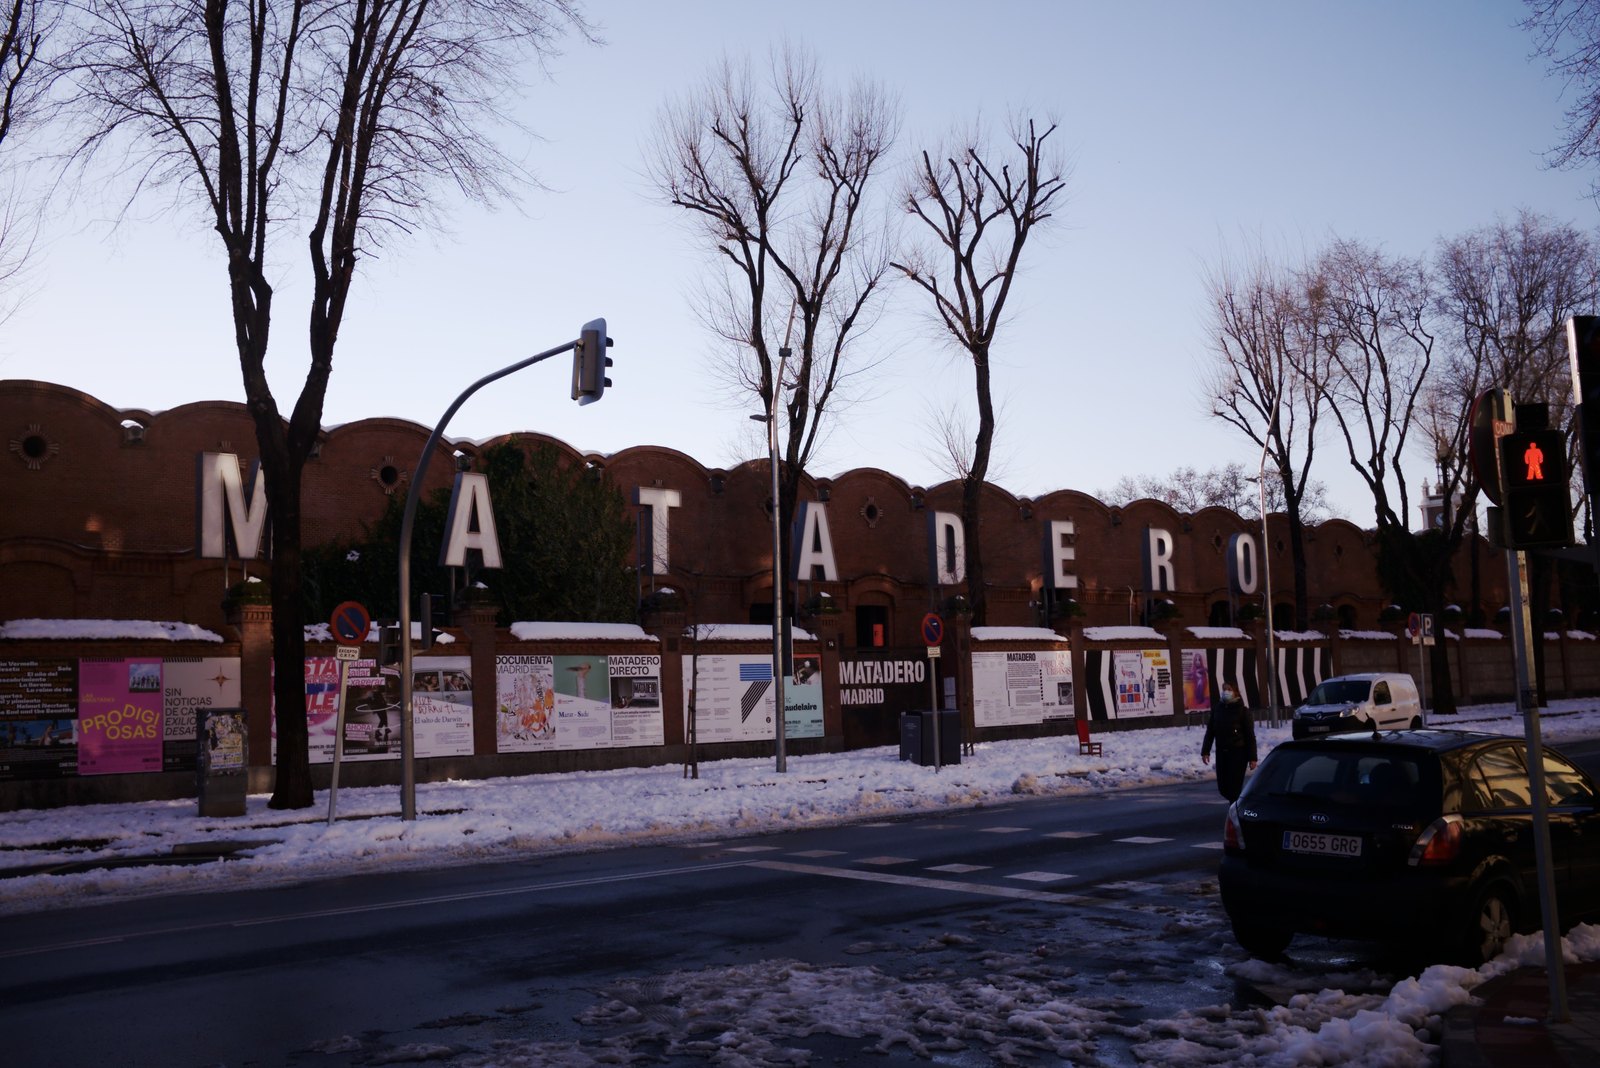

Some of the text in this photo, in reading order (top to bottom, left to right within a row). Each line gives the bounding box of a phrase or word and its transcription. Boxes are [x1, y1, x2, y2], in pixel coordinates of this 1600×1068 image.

[1424, 617, 1432, 635] P
[496, 656, 553, 665] DOCUMENTA
[609, 656, 660, 665] MATADERO
[1006, 653, 1036, 662] MATADERO
[496, 665, 530, 674] MADRID
[609, 666, 649, 675] DIRECTO
[839, 660, 925, 685] MATADERO
[165, 688, 182, 697] SIN
[840, 687, 885, 705] MADRID
[165, 697, 213, 706] NOTICIAS
[165, 707, 178, 716] DE
[784, 702, 818, 712] audelaire
[81, 703, 160, 735] PRODIGI
[105, 724, 157, 740] OSAS
[1311, 814, 1327, 823] KIA
[1293, 834, 1358, 853] 0655 GRG
